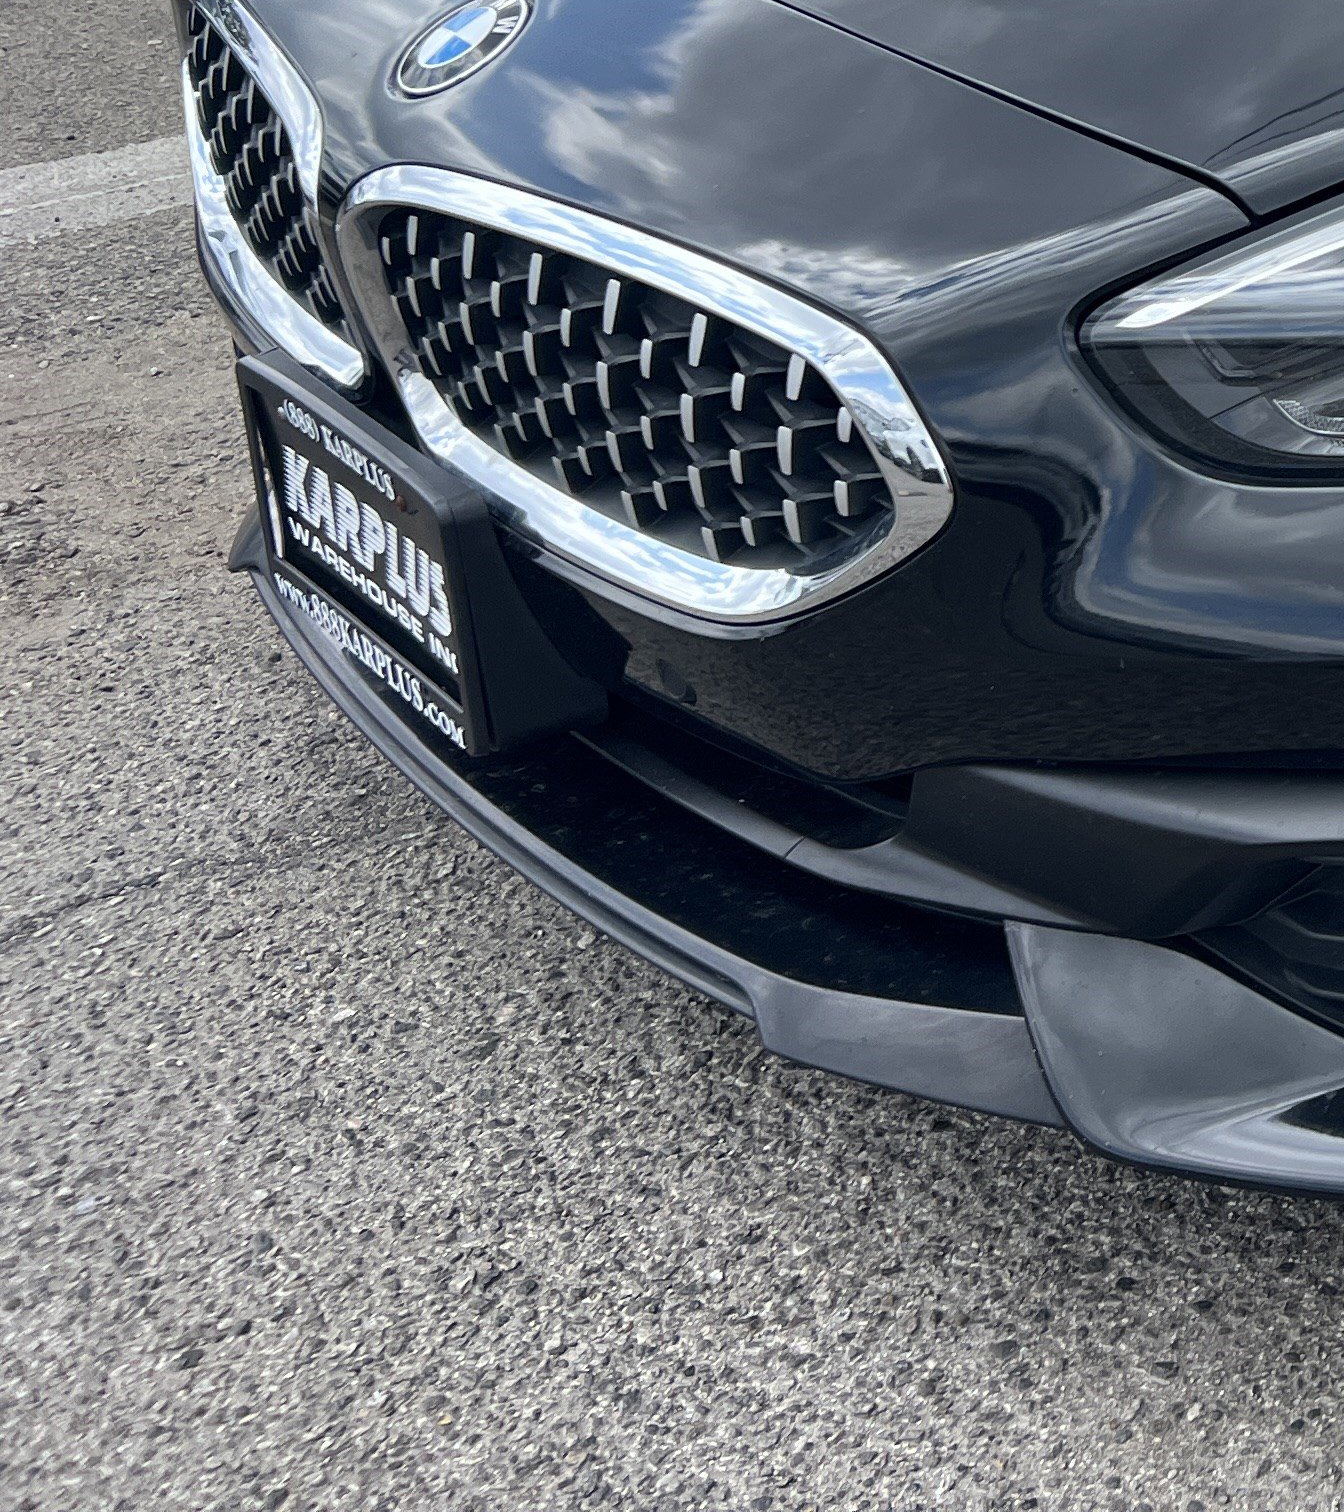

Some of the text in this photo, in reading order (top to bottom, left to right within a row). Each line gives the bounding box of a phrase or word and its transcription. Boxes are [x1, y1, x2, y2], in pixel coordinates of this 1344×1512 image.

[283, 399, 396, 501] (888) KARPLUS
[282, 444, 452, 636] KARPLUS
[287, 516, 425, 643] WAREHOUSE
